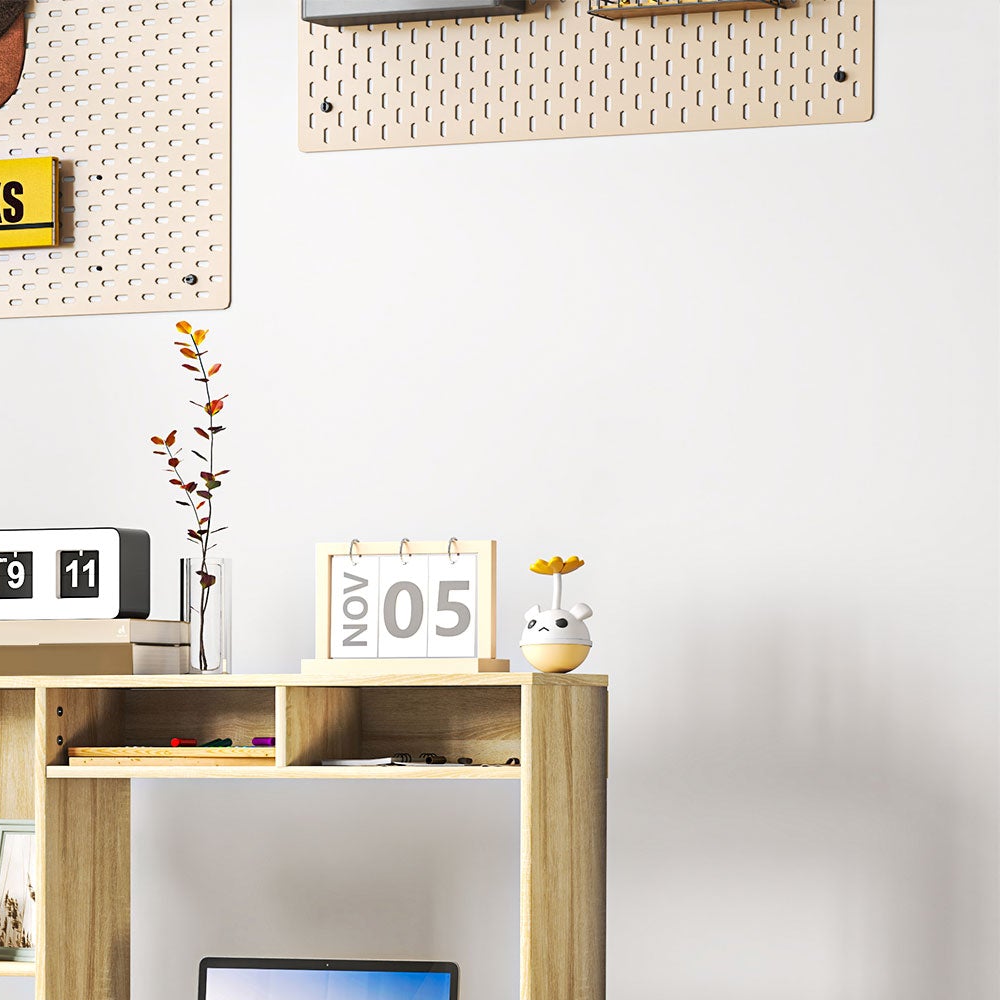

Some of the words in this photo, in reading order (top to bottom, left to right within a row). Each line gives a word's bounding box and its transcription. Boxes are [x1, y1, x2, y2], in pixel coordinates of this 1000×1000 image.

[7, 560, 25, 589] 9
[65, 559, 95, 588] 11
[342, 572, 369, 647] NOV
[383, 580, 471, 639] 05
